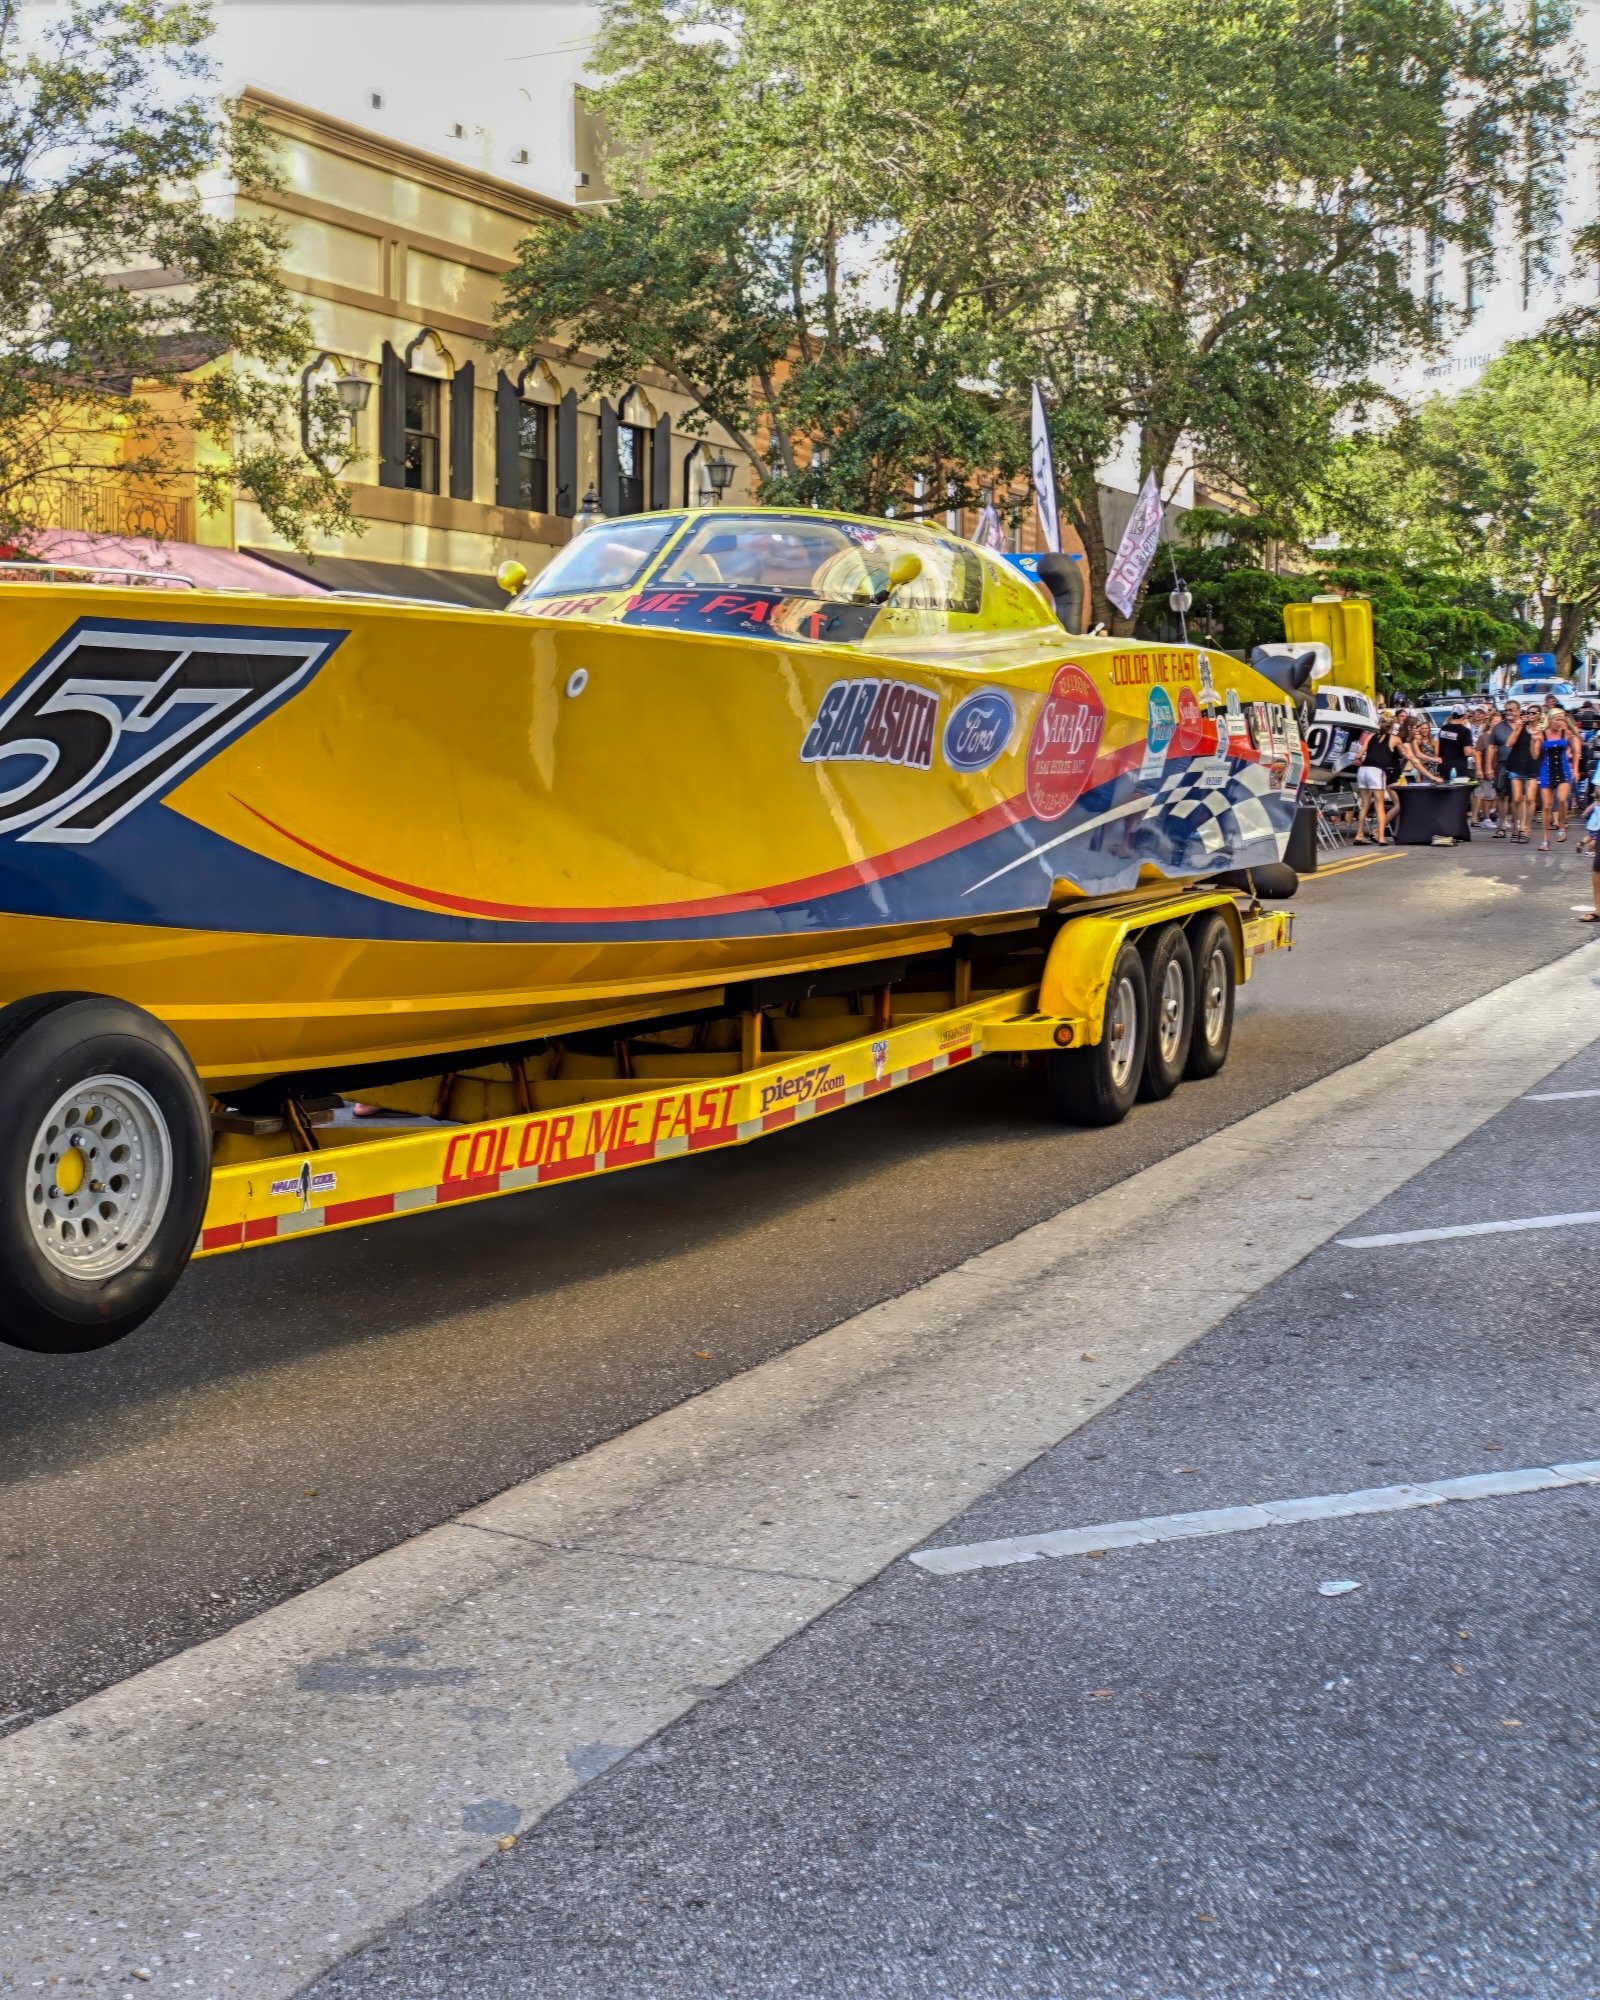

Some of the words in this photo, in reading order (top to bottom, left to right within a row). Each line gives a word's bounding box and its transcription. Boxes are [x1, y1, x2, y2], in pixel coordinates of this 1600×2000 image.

[611, 592, 700, 613] ME
[698, 595, 829, 641] FAT
[1113, 653, 1150, 686] COLOR
[1152, 652, 1169, 683] ME
[1171, 652, 1196, 682] FAST
[0, 629, 329, 844] 57
[801, 677, 940, 770] SARASOTA
[956, 707, 1002, 753] Ford
[760, 1063, 845, 1113] pier57.com
[442, 1115, 573, 1185] COLOR
[584, 1105, 644, 1156] ME
[648, 1084, 740, 1144] FAST
